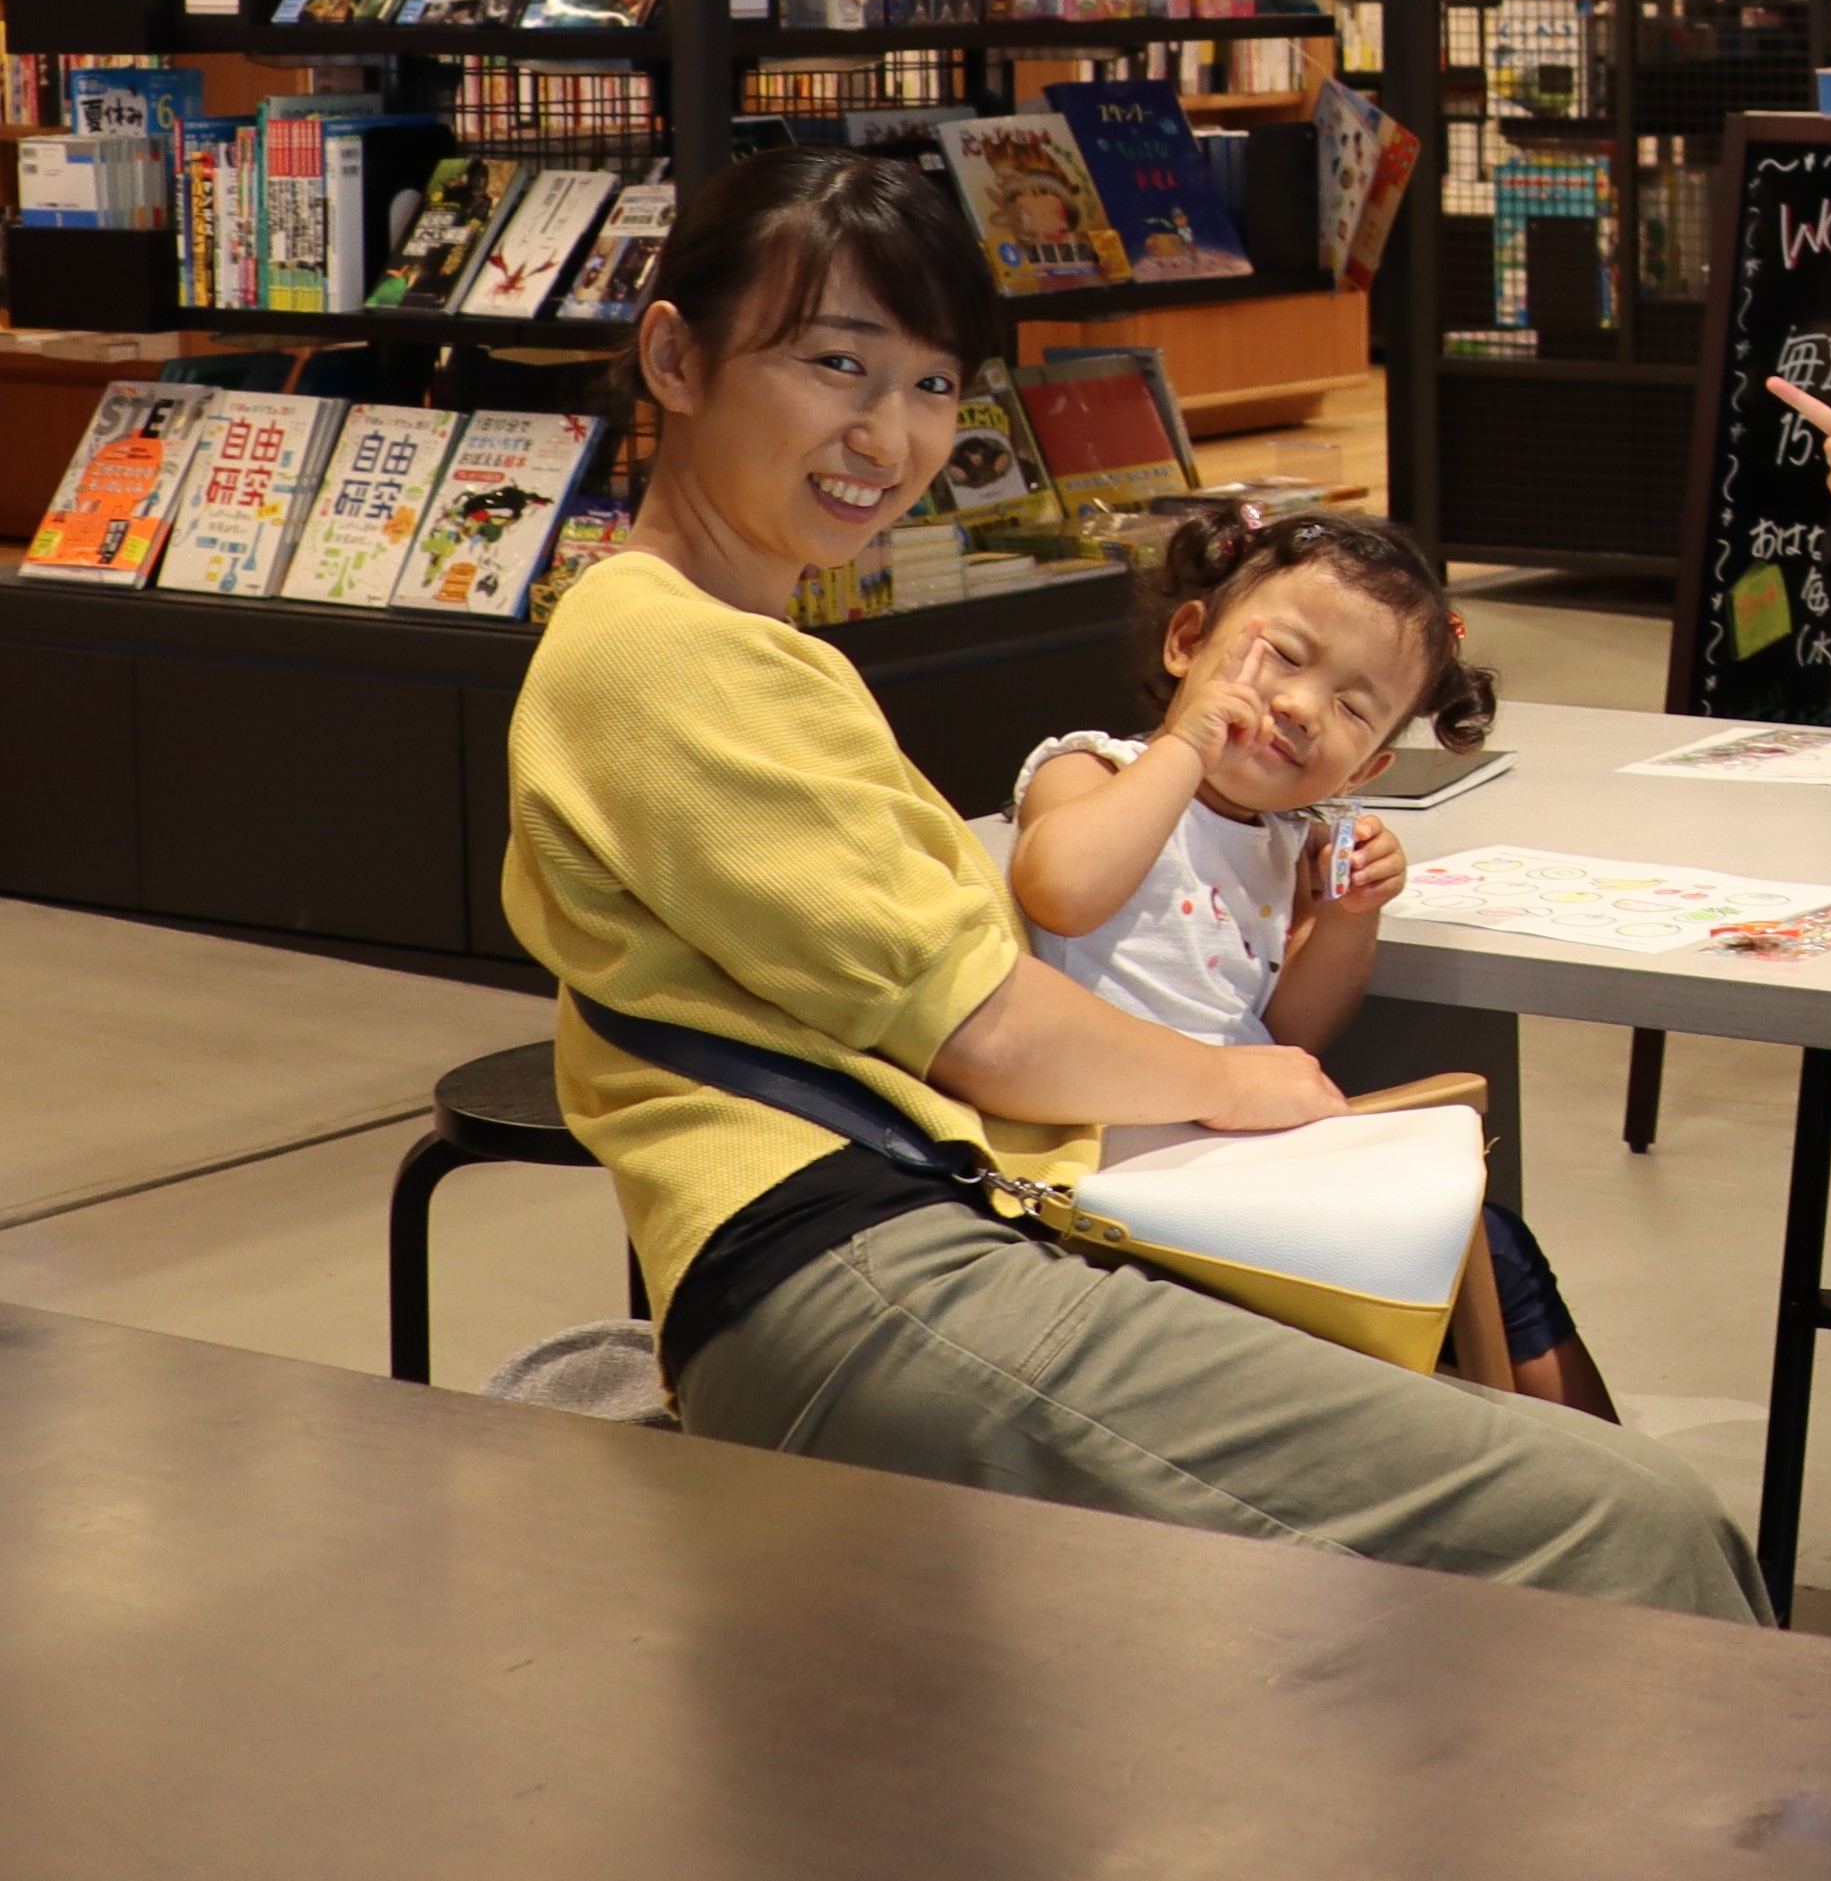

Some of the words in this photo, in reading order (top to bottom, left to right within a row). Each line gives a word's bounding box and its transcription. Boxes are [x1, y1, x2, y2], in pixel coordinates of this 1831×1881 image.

[155, 94, 175, 129] 6
[220, 417, 284, 463] 自由
[352, 429, 418, 476] 自由
[206, 466, 273, 509] 研究
[333, 478, 403, 520] 研究
